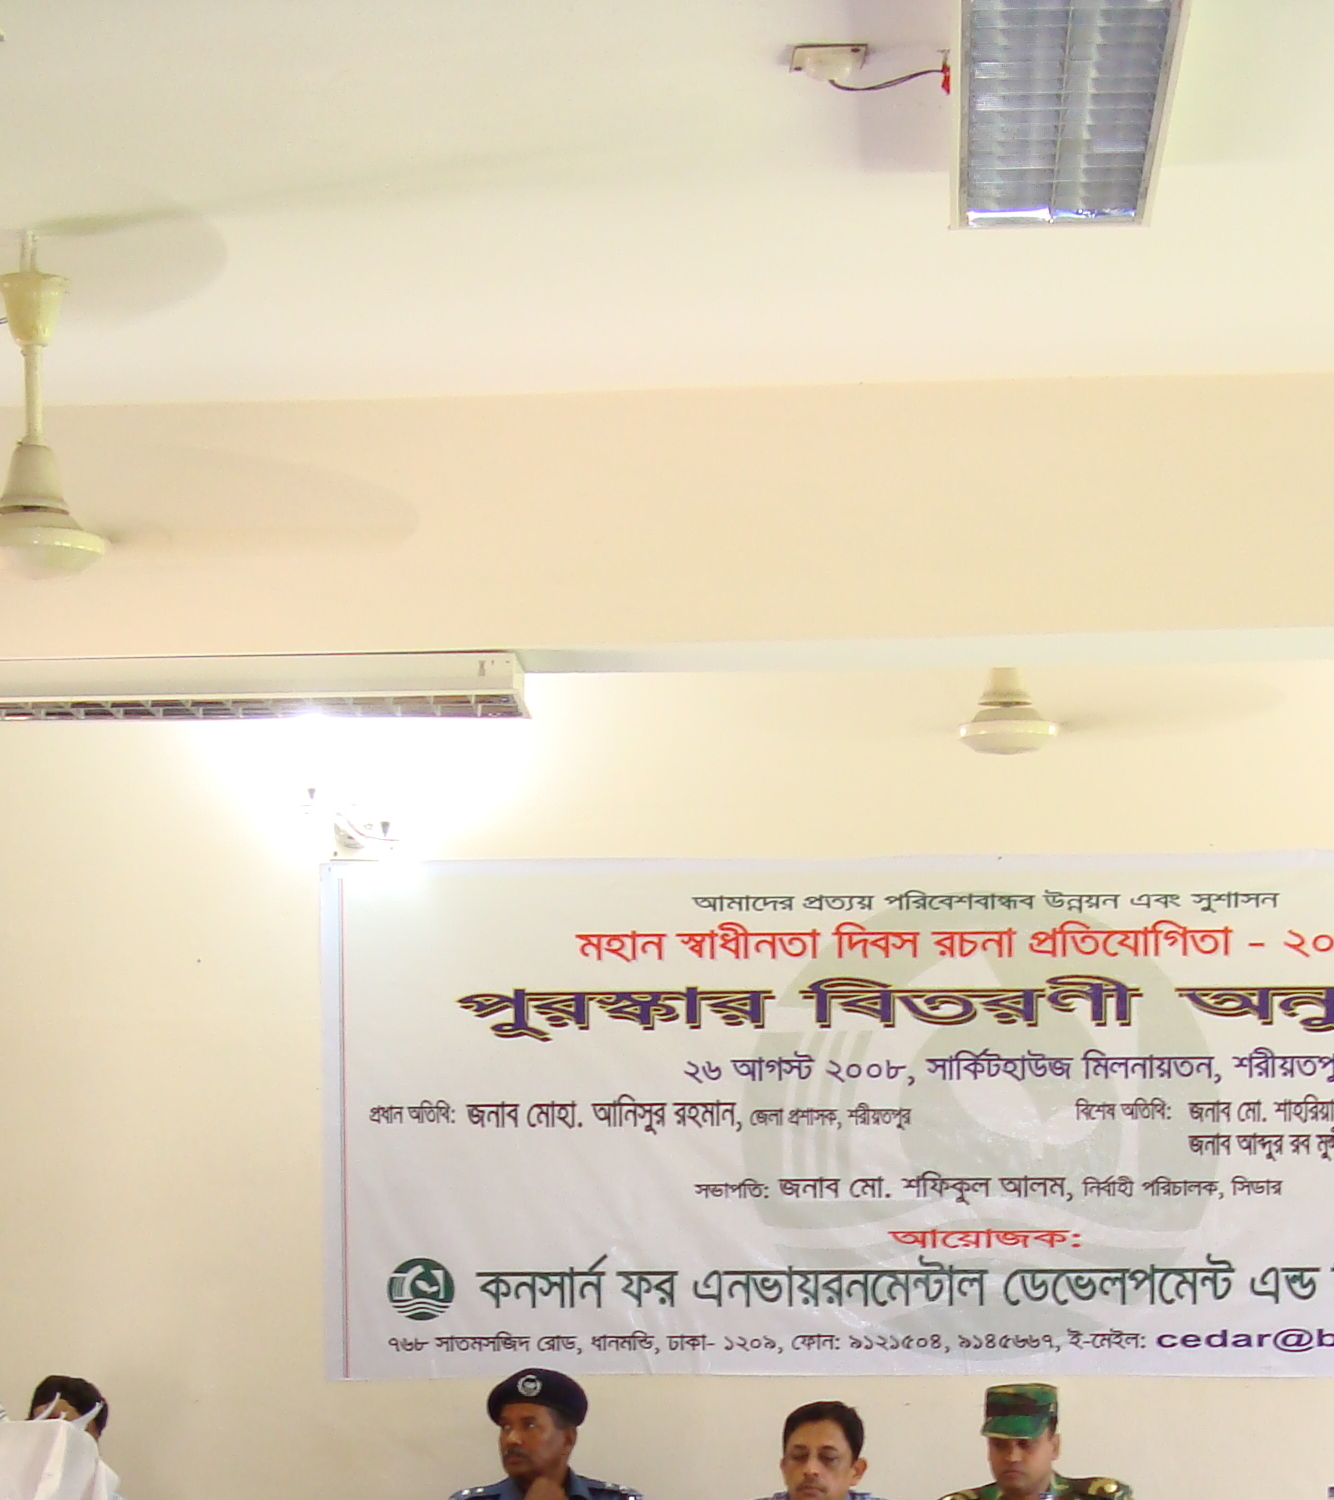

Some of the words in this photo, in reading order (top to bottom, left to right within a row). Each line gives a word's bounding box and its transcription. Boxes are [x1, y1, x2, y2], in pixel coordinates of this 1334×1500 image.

[692, 895, 794, 911] আমাদের
[803, 895, 874, 911] প্রত্যয়
[885, 890, 1035, 910] পরিবেশবান্ধব
[1043, 889, 1120, 913] উন্নয়ন
[1130, 894, 1180, 908] এবং
[1191, 892, 1280, 913] সুশাসন
[575, 931, 666, 962] মহান
[676, 922, 821, 959] স্বাধীনতা
[832, 922, 920, 958] দিবস
[931, 928, 1016, 957] রচনা
[1029, 920, 1233, 957] প্রতিযোগিতা
[457, 986, 775, 1042] পুরস্কার
[798, 974, 1143, 1028] বিতরণী
[684, 1061, 721, 1083] ২৬
[731, 1051, 815, 1081] আগস্ট
[826, 1060, 915, 1086] ২০০৮,
[925, 1048, 1074, 1081] সার্কিটহাউজ
[1081, 1049, 1221, 1083] মিলনায়তন,
[695, 1178, 769, 1199] সভাপতি:
[778, 1177, 841, 1198] জনাব
[850, 1176, 890, 1198] মো.
[901, 1171, 992, 1205] শফিকুল
[998, 1175, 1073, 1201] আলম,
[1142, 1176, 1223, 1199] পরিচালক,
[1231, 1176, 1283, 1195] সিডার
[888, 1229, 1081, 1248] আয়োজক:
[476, 1254, 607, 1308] কনসার্ন
[616, 1271, 678, 1307] ফর
[1003, 1253, 1235, 1306] ডেভেলপমেন্ট
